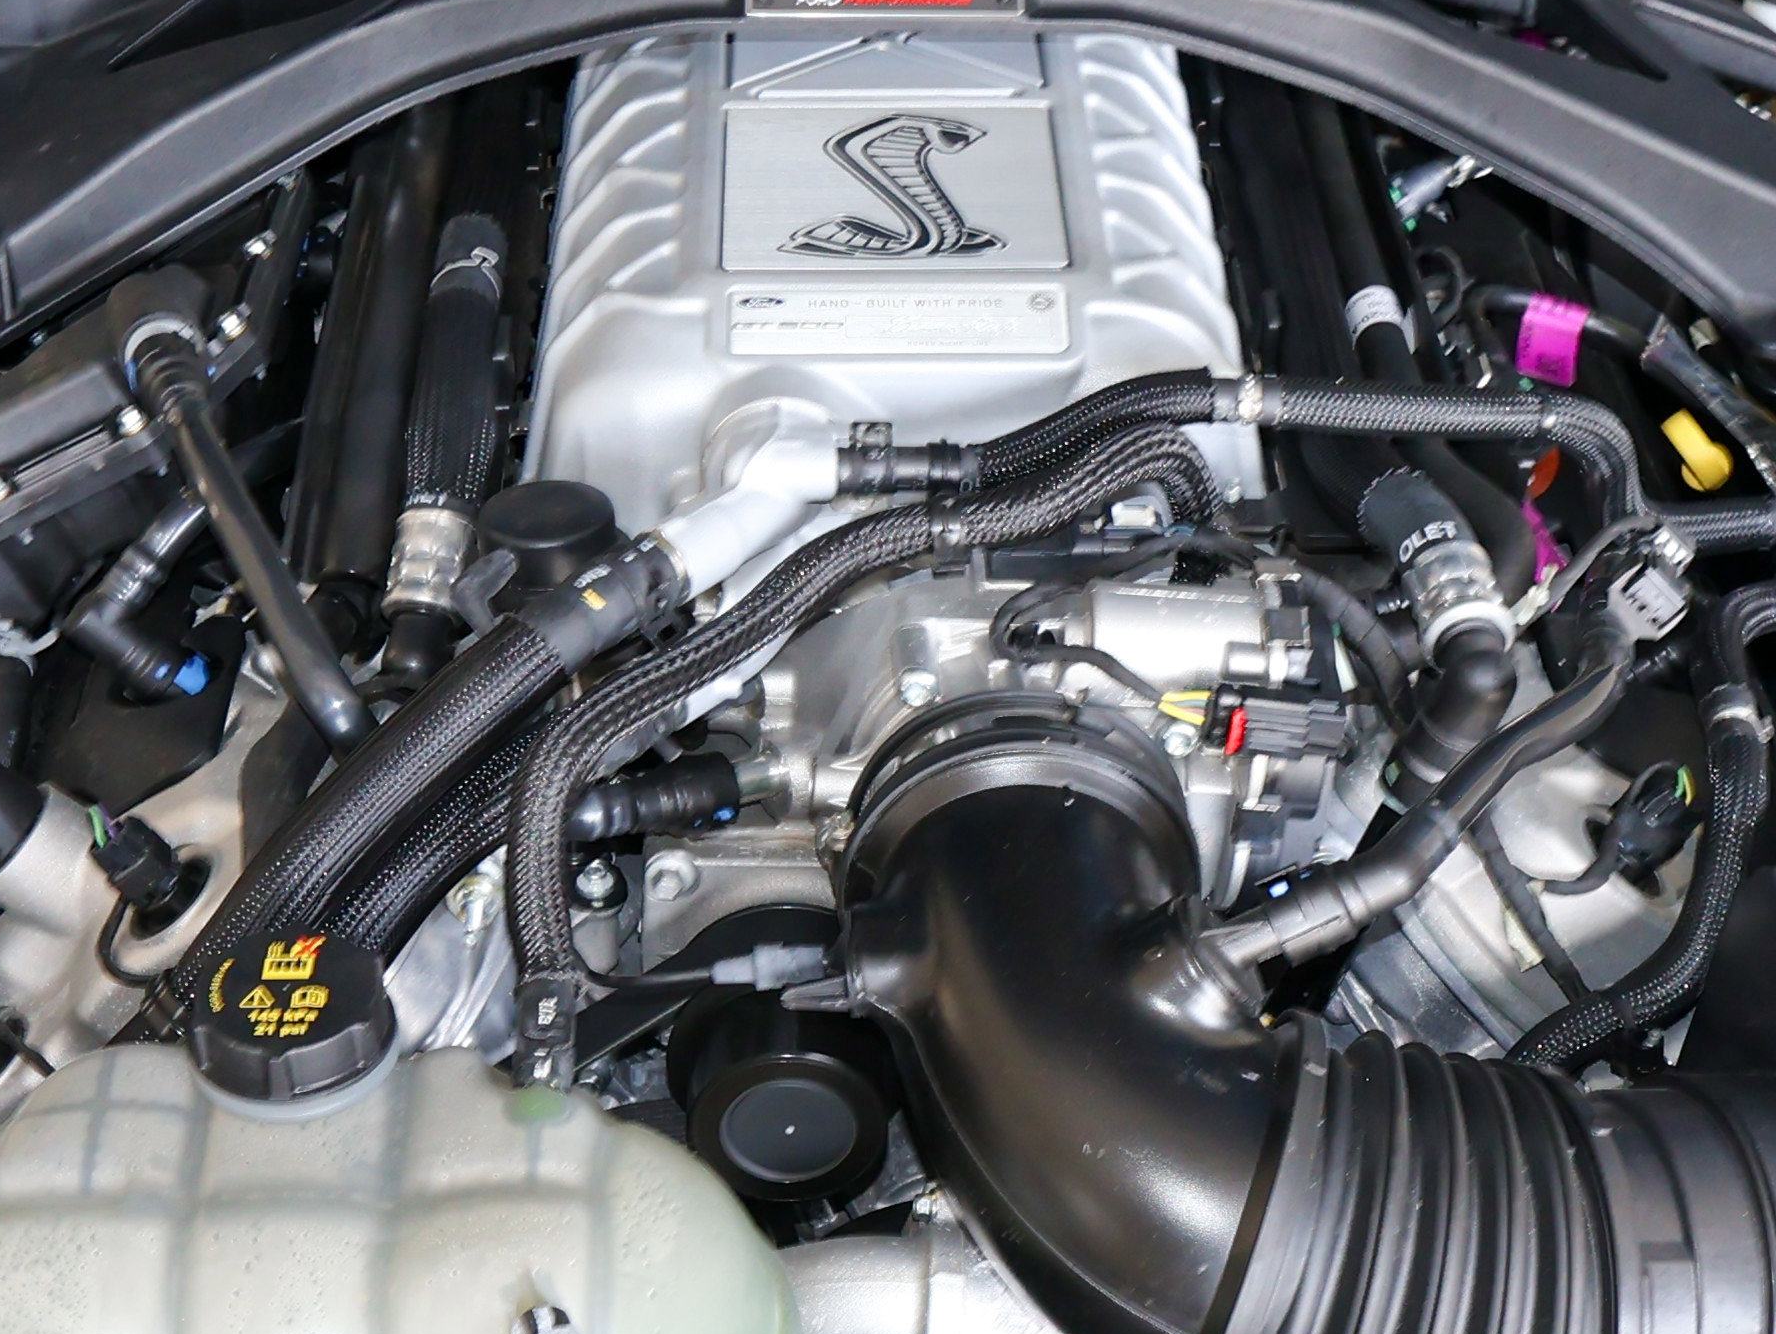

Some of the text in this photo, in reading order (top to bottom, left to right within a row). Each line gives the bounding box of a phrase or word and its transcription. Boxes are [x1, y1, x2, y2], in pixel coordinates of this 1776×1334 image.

[808, 299, 849, 308] HAND
[866, 299, 906, 308] BUILT
[913, 299, 951, 308] WITH
[957, 298, 1004, 308] PRIDE
[283, 1008, 320, 1023] kPa
[253, 1022, 310, 1038] 21 psi
